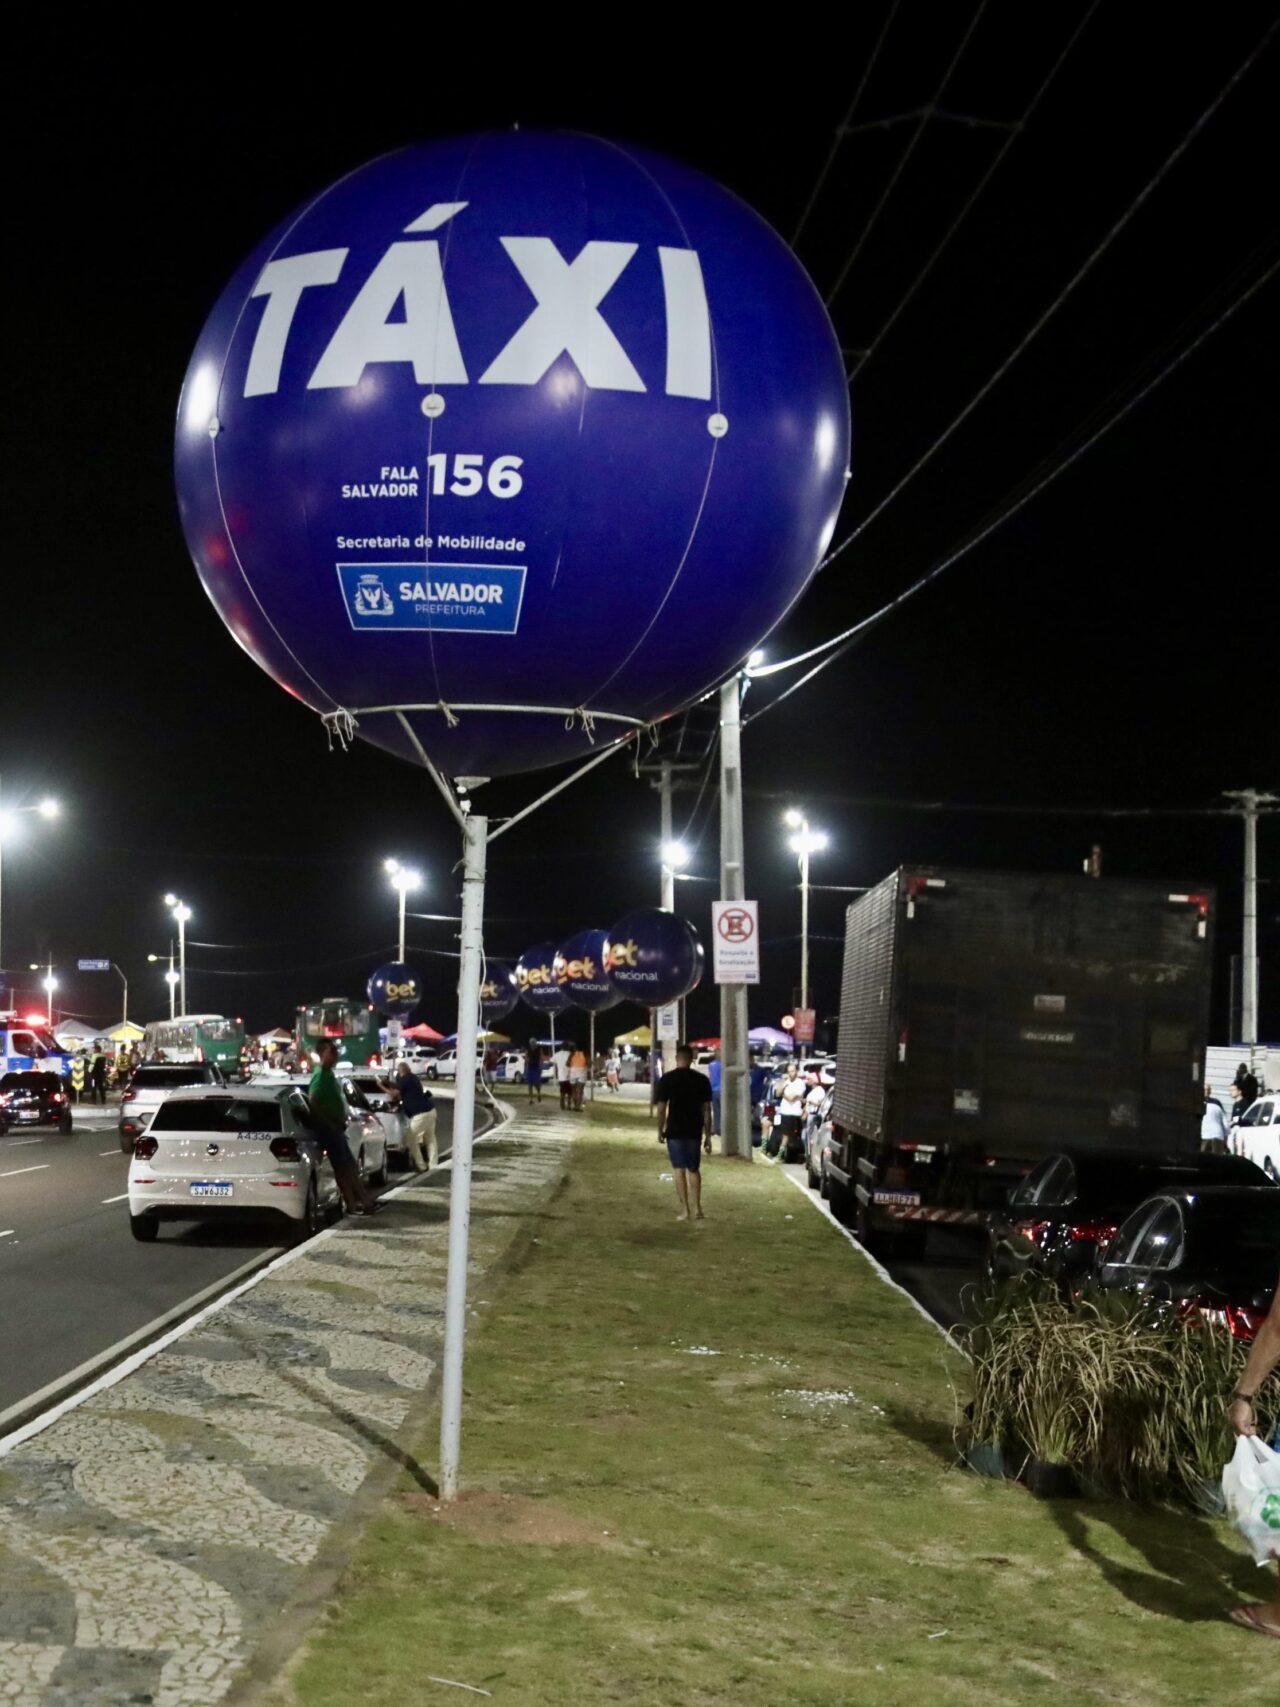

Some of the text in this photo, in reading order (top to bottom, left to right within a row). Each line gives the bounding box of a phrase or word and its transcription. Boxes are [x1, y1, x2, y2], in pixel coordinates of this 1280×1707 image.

[243, 201, 711, 401] TÁXI
[381, 466, 419, 480] FALA
[427, 453, 524, 499] 156
[341, 483, 418, 498] SALVADOR
[336, 535, 526, 552] Secretaria de Mobilidade
[399, 582, 504, 604] SALVADOR
[415, 604, 486, 616] PREFEITURA
[517, 964, 551, 986] bet
[614, 970, 658, 981] nacional
[386, 980, 416, 997] bet
[480, 980, 498, 997] et
[532, 986, 561, 994] nacion
[571, 982, 609, 992] nacional
[237, 1132, 271, 1141] A4336
[194, 1187, 230, 1196] SJW6J32
